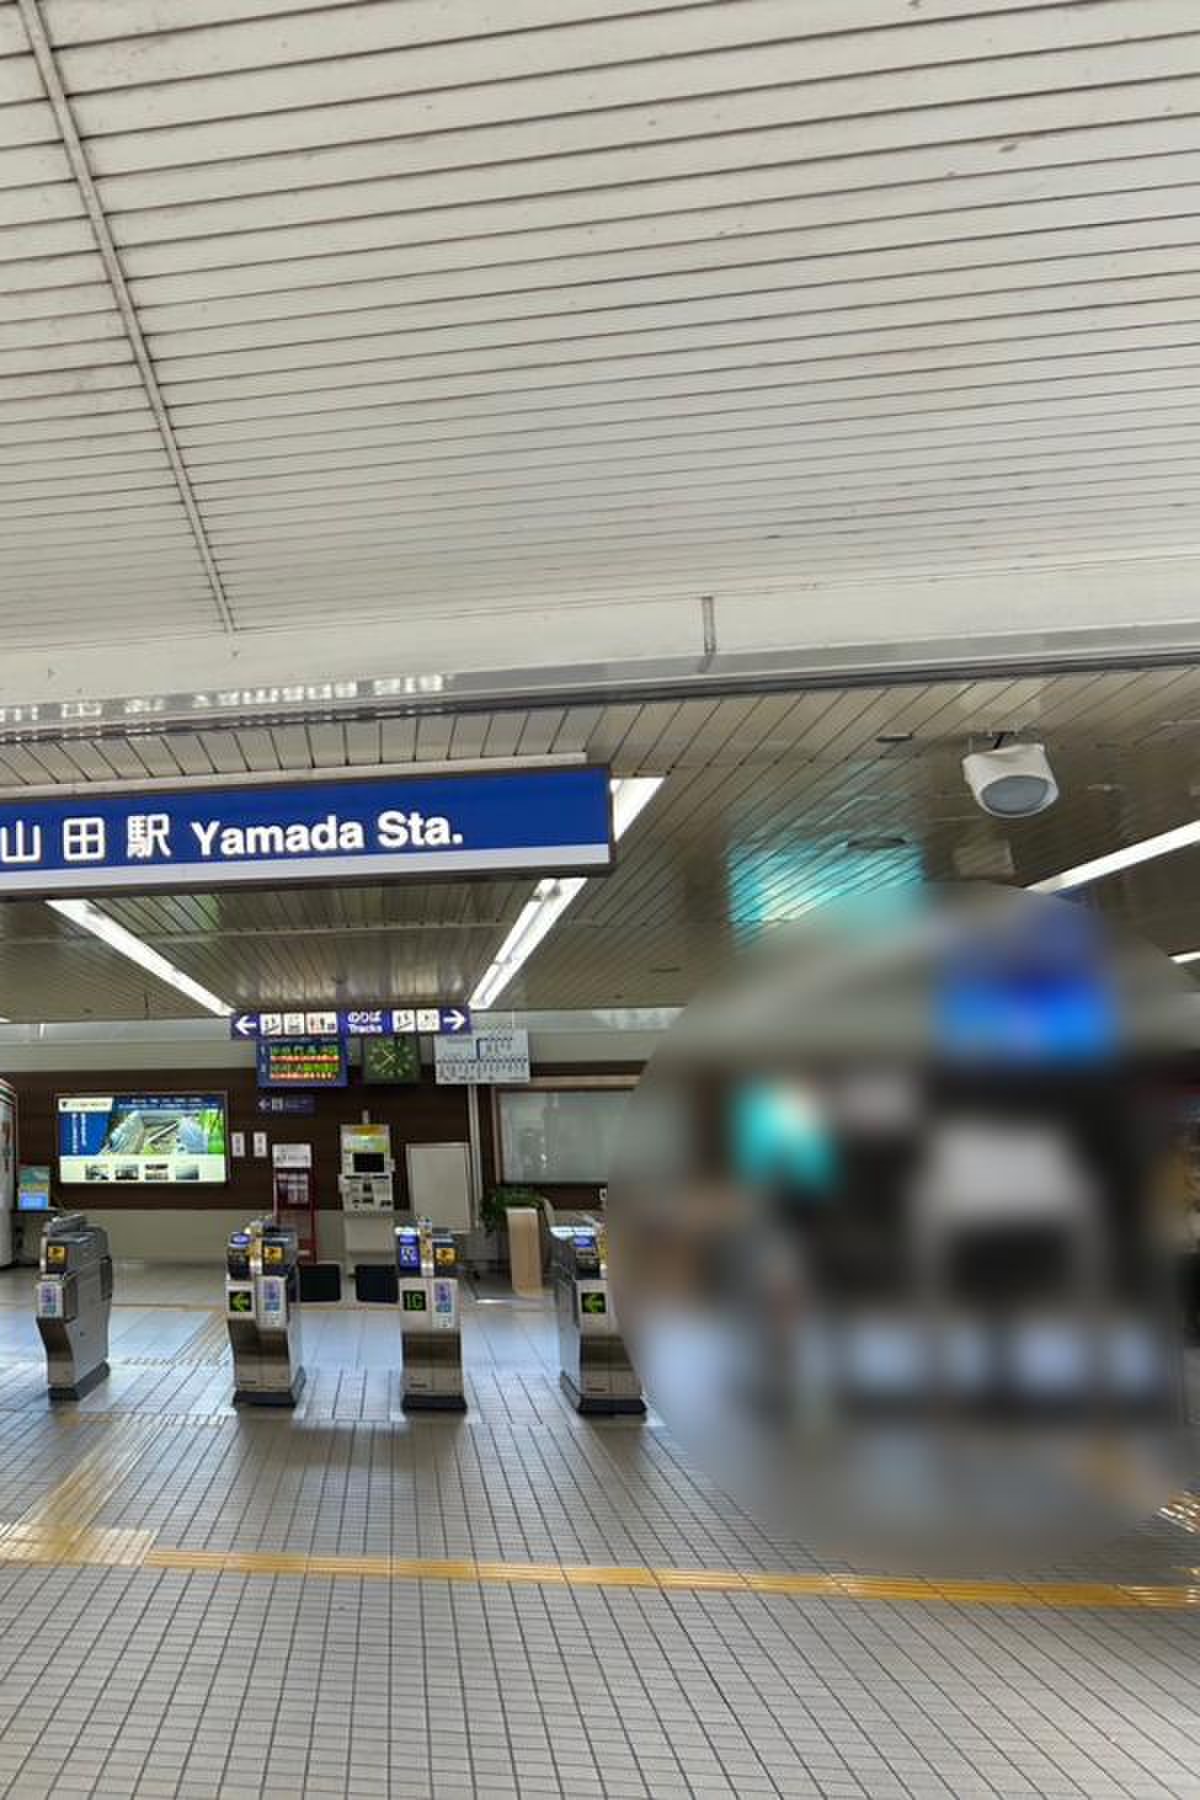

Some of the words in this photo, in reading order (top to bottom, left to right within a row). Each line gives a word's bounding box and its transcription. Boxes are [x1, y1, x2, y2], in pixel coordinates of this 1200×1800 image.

[0, 813, 172, 863] 山田駅
[190, 814, 365, 856] Yamada
[377, 810, 464, 848] Sta.
